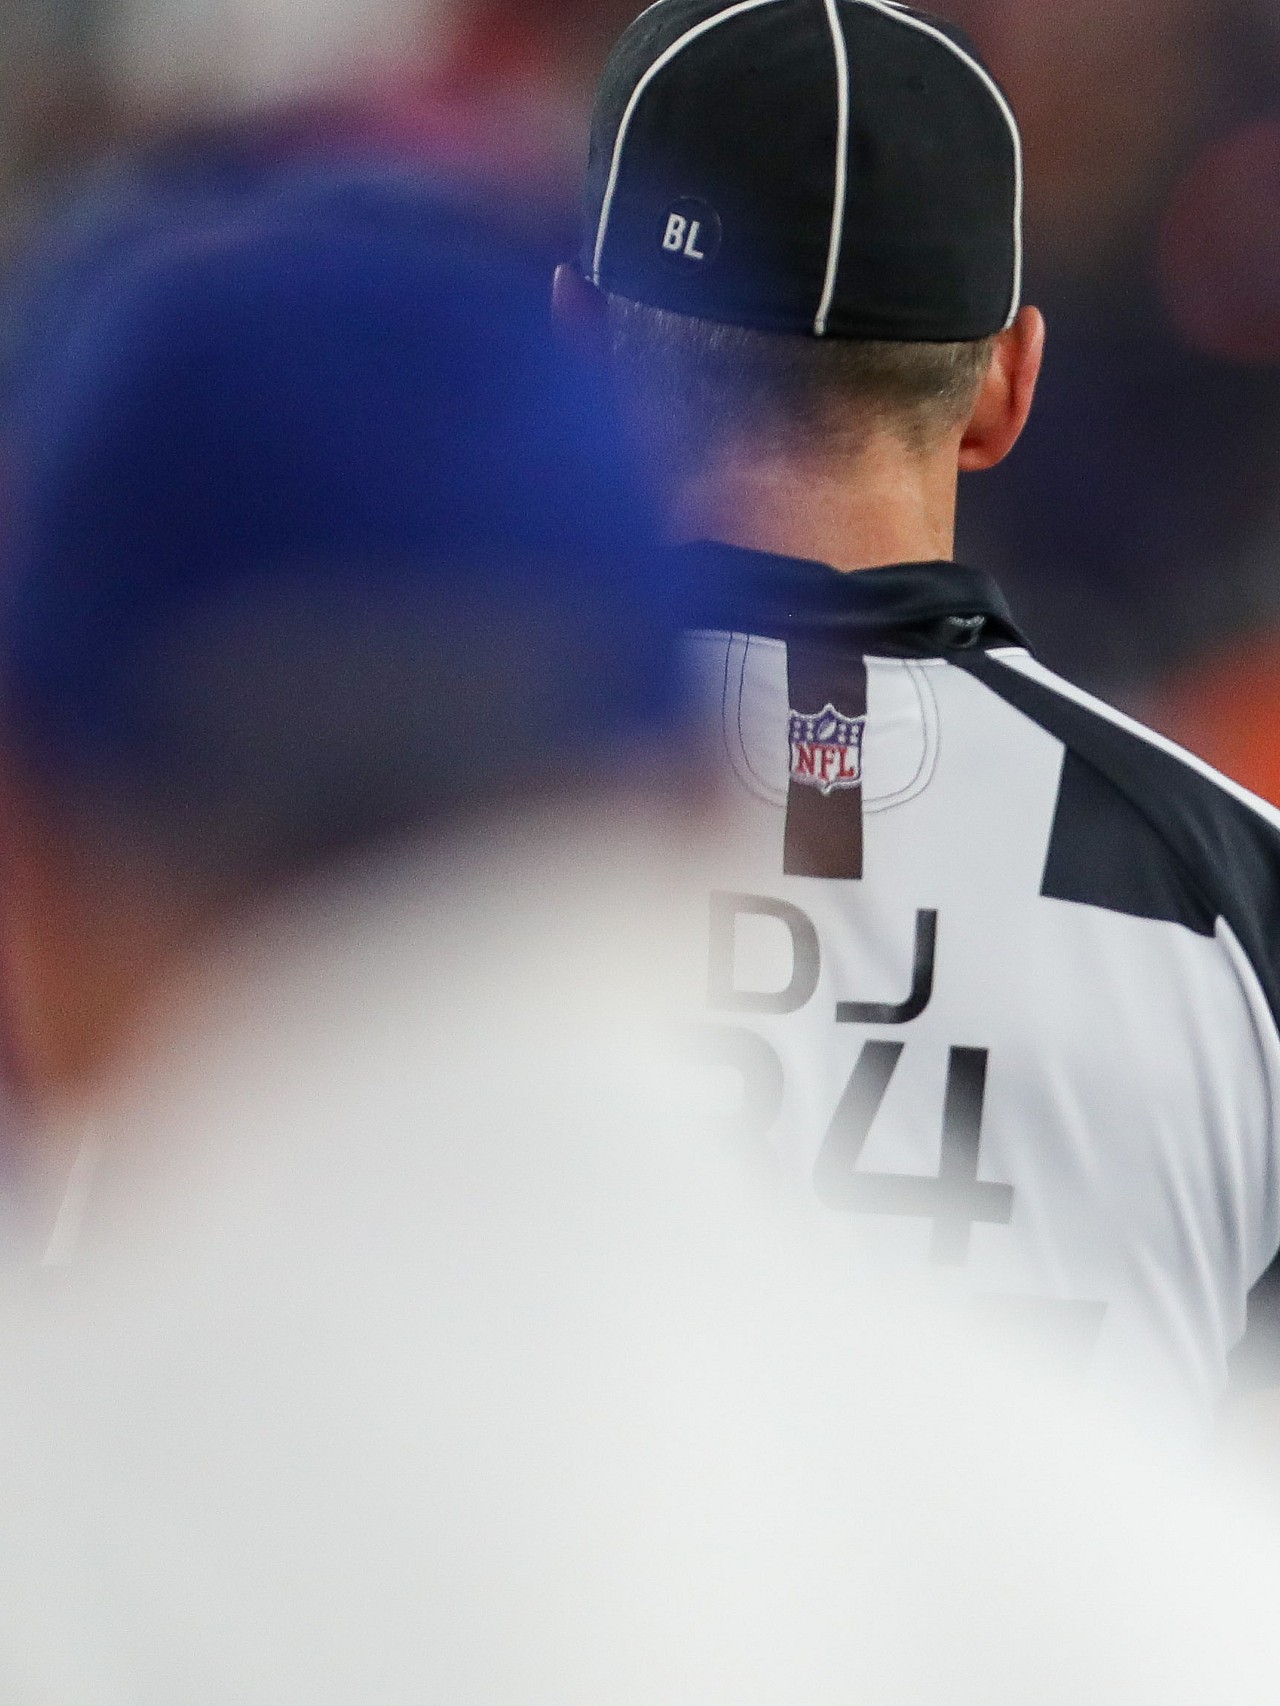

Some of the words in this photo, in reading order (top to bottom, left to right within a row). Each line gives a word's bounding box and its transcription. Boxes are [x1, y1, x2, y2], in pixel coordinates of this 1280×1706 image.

[662, 212, 704, 260] BL
[795, 742, 855, 780] NFL
[706, 889, 938, 1025] DJ
